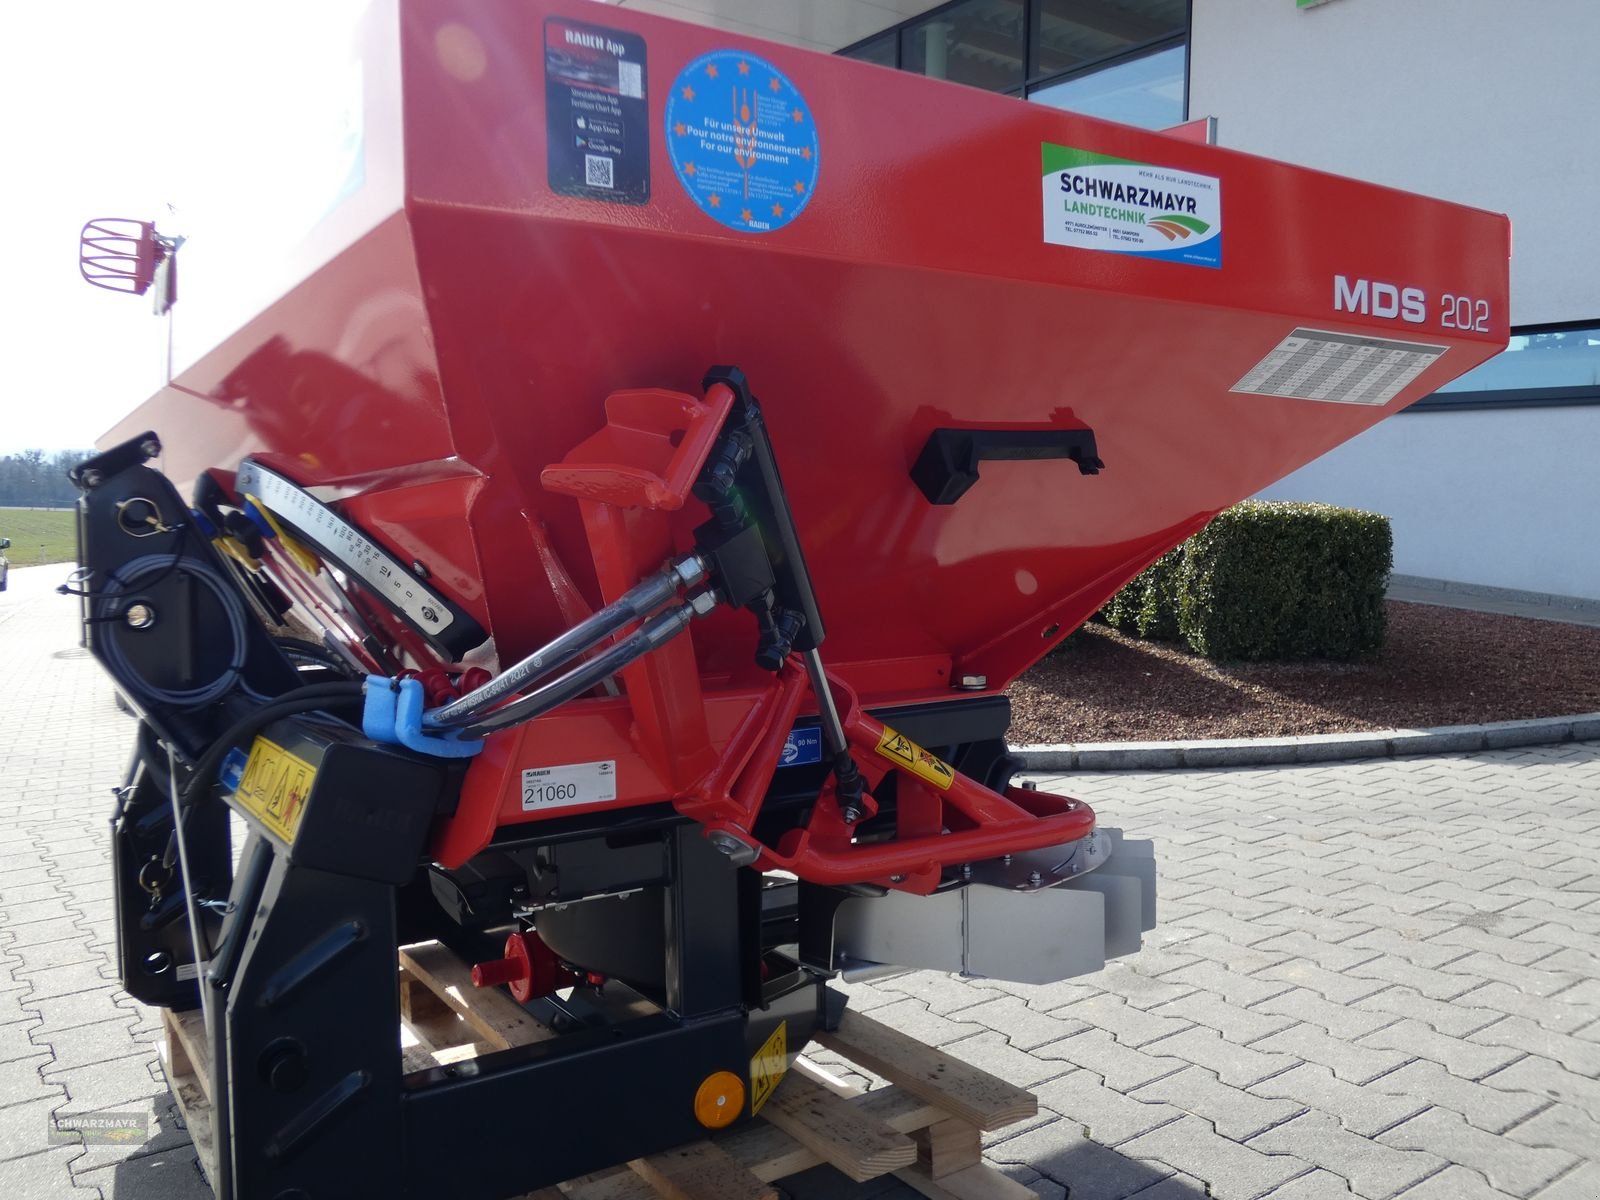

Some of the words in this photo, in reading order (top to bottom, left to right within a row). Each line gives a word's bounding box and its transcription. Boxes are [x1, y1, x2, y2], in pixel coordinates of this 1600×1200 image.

[565, 30, 604, 50] RAUCH
[606, 39, 624, 56] App
[611, 106, 622, 116] App
[588, 122, 602, 132] App
[603, 125, 620, 134] Store
[704, 117, 718, 129] Für
[721, 122, 750, 135] unsere
[752, 125, 785, 141] Umwelt
[687, 125, 708, 138] Pour
[711, 131, 734, 143] notre
[736, 135, 800, 156] environnement
[588, 142, 608, 152] Google
[610, 145, 621, 154] Play
[700, 140, 715, 150] For
[717, 144, 732, 153] our
[734, 146, 789, 164] environment
[1139, 170, 1153, 178] MEHR
[1061, 172, 1196, 214] SCHWARZMAYR
[1064, 200, 1146, 224] LANDTECHNIK
[1334, 275, 1425, 323] MDS
[1441, 294, 1488, 332] 20.2
[339, 526, 348, 539] 100
[355, 538, 363, 548] 50
[364, 545, 371, 555] 30
[373, 552, 380, 560] 15
[380, 566, 388, 576] 10
[524, 784, 576, 804] 21060
